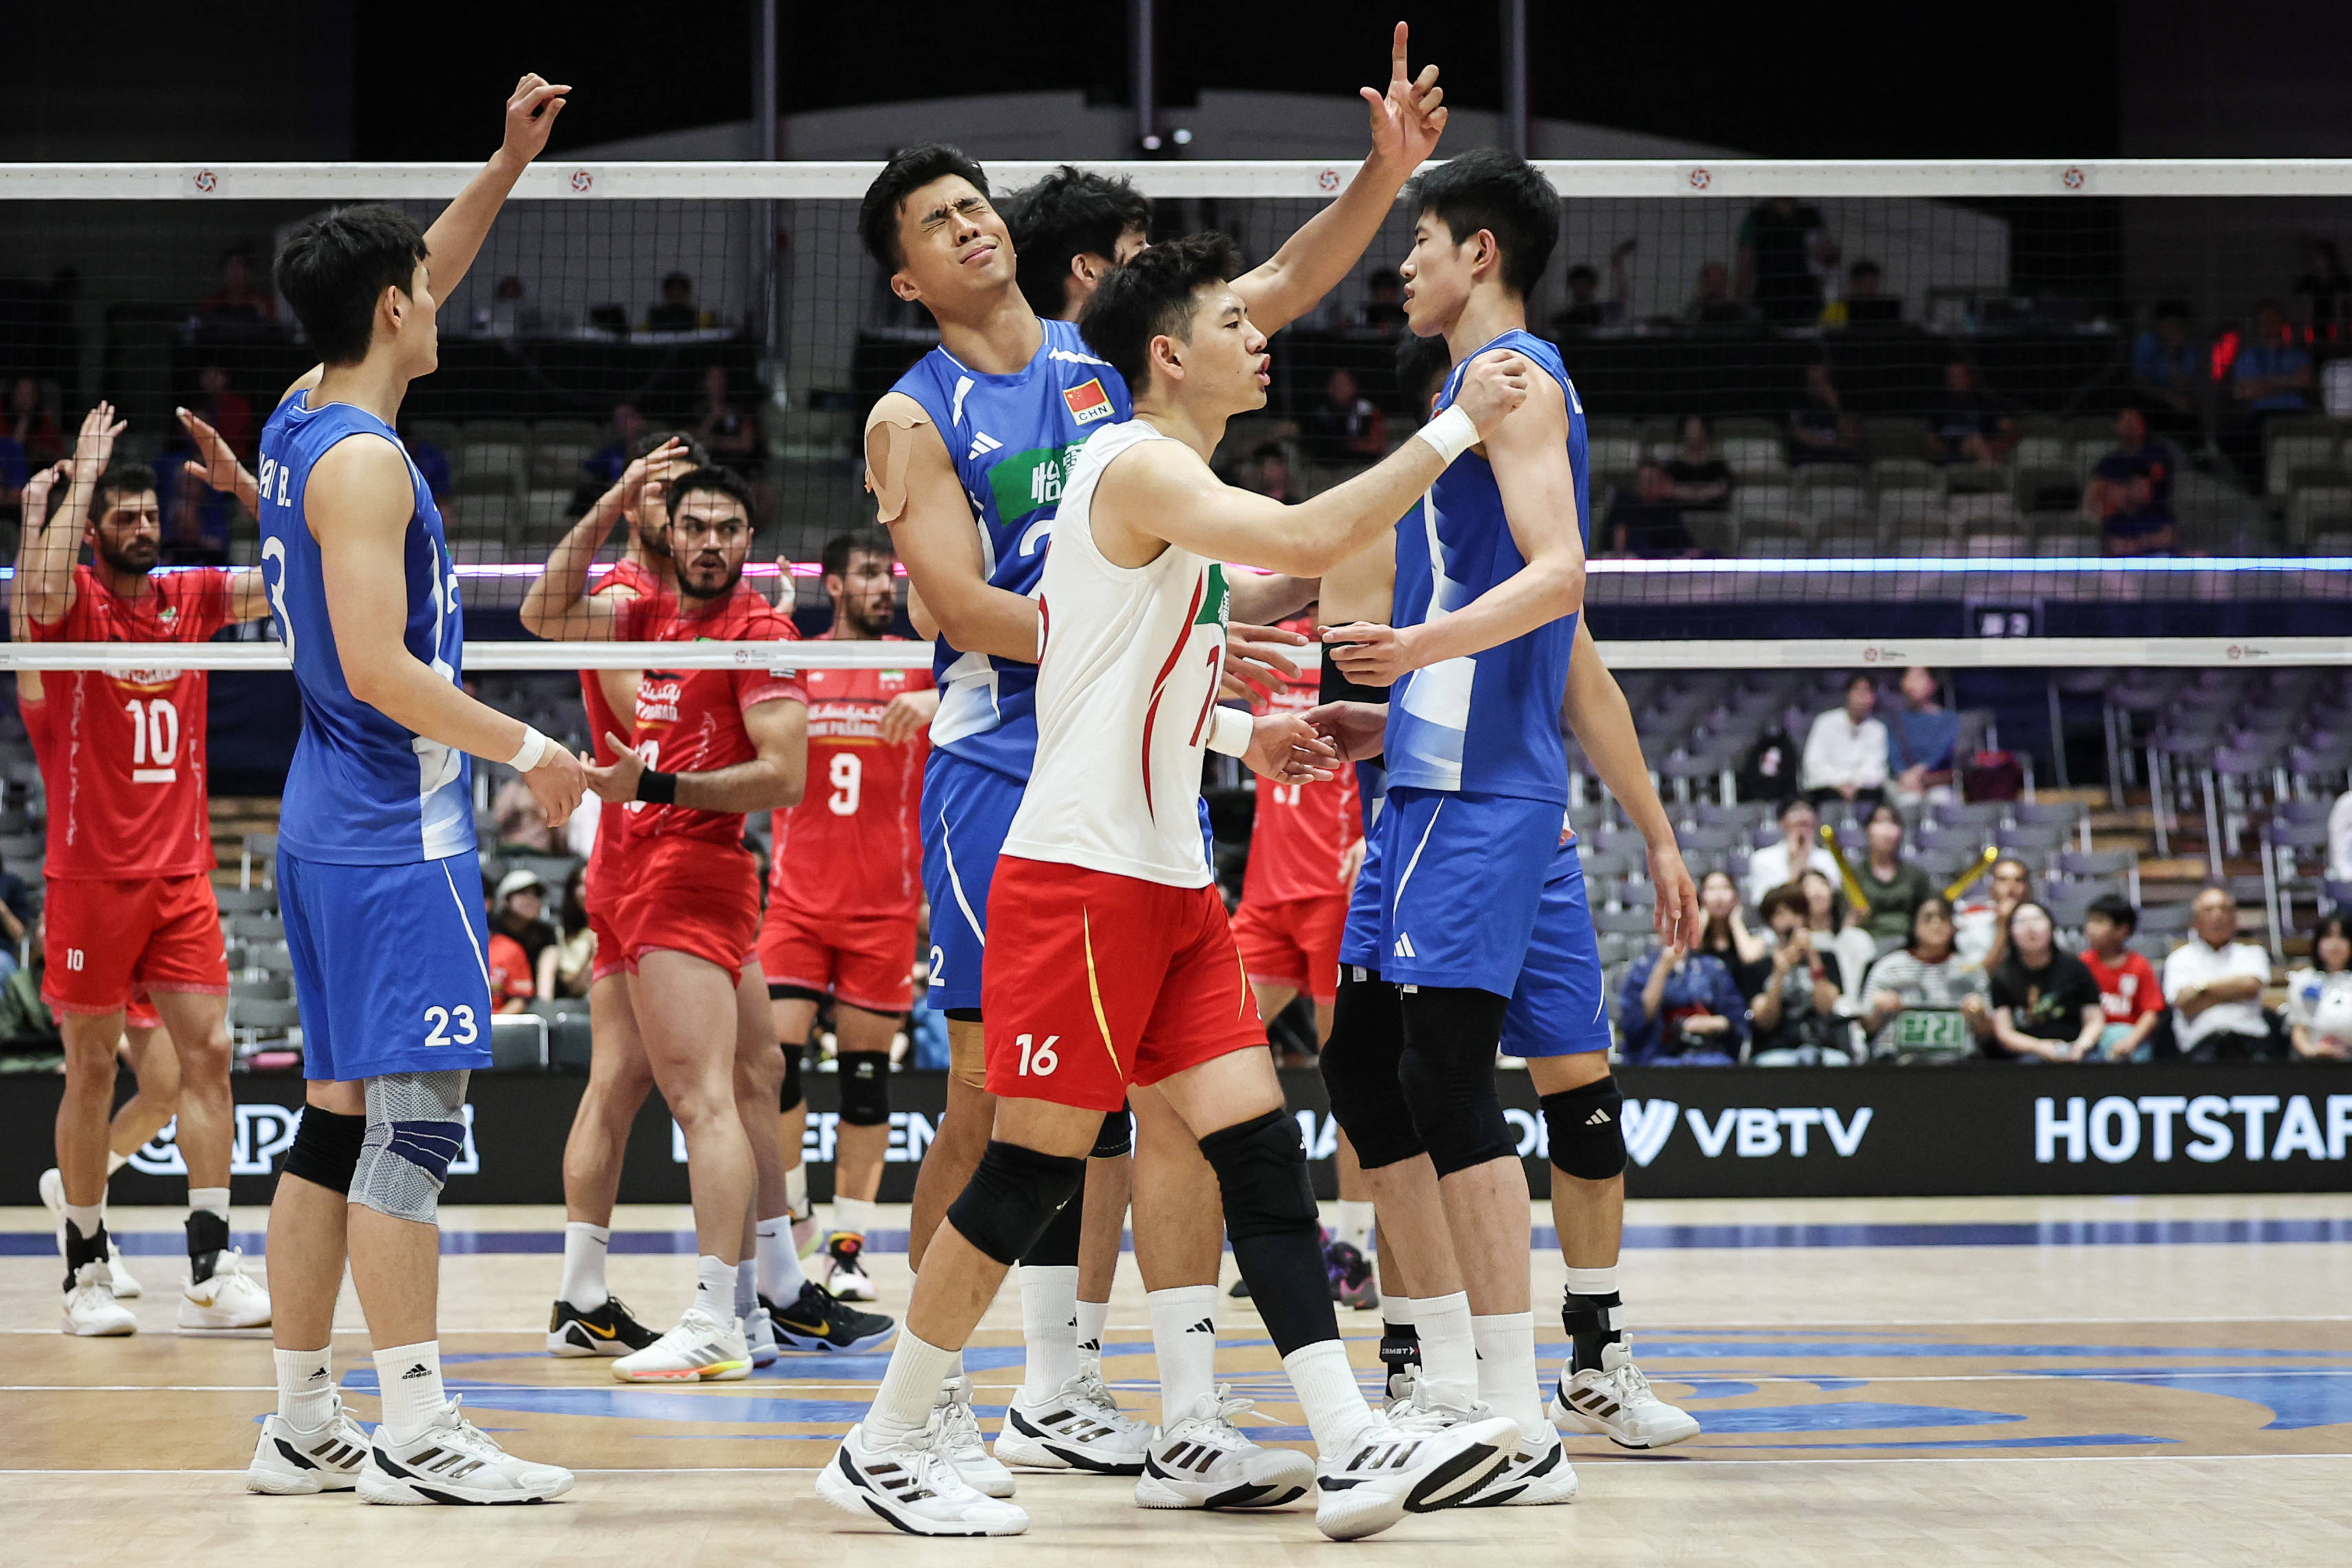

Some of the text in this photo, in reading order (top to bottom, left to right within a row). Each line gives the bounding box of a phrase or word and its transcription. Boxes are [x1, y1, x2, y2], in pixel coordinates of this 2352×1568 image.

[1079, 405, 1108, 421] CHN
[277, 466, 291, 508] B.
[1189, 644, 1220, 747] 1
[125, 699, 179, 765] 10
[828, 752, 862, 816] 9
[67, 948, 84, 971] 10
[928, 945, 946, 987] 2
[424, 1004, 478, 1047] 23
[1015, 1034, 1060, 1076] 16
[1685, 1107, 1873, 1157] VBTV
[402, 1370, 432, 1379] adidas
